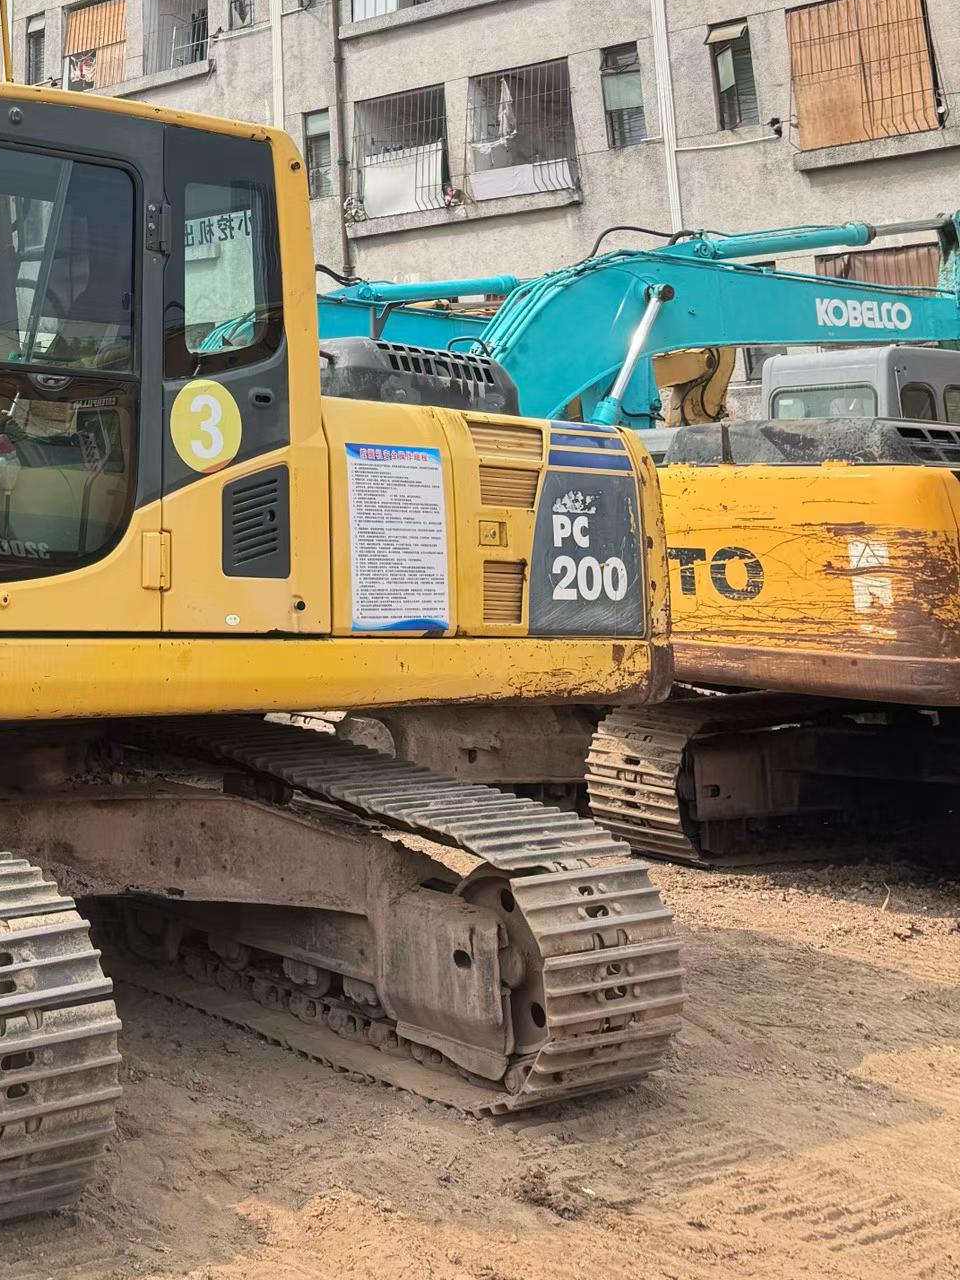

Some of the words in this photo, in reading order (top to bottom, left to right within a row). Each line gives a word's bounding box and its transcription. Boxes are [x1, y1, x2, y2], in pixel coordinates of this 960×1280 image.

[815, 297, 912, 330] KOBELCO
[189, 393, 224, 459] 3
[552, 514, 590, 548] PC
[552, 555, 628, 601] 200
